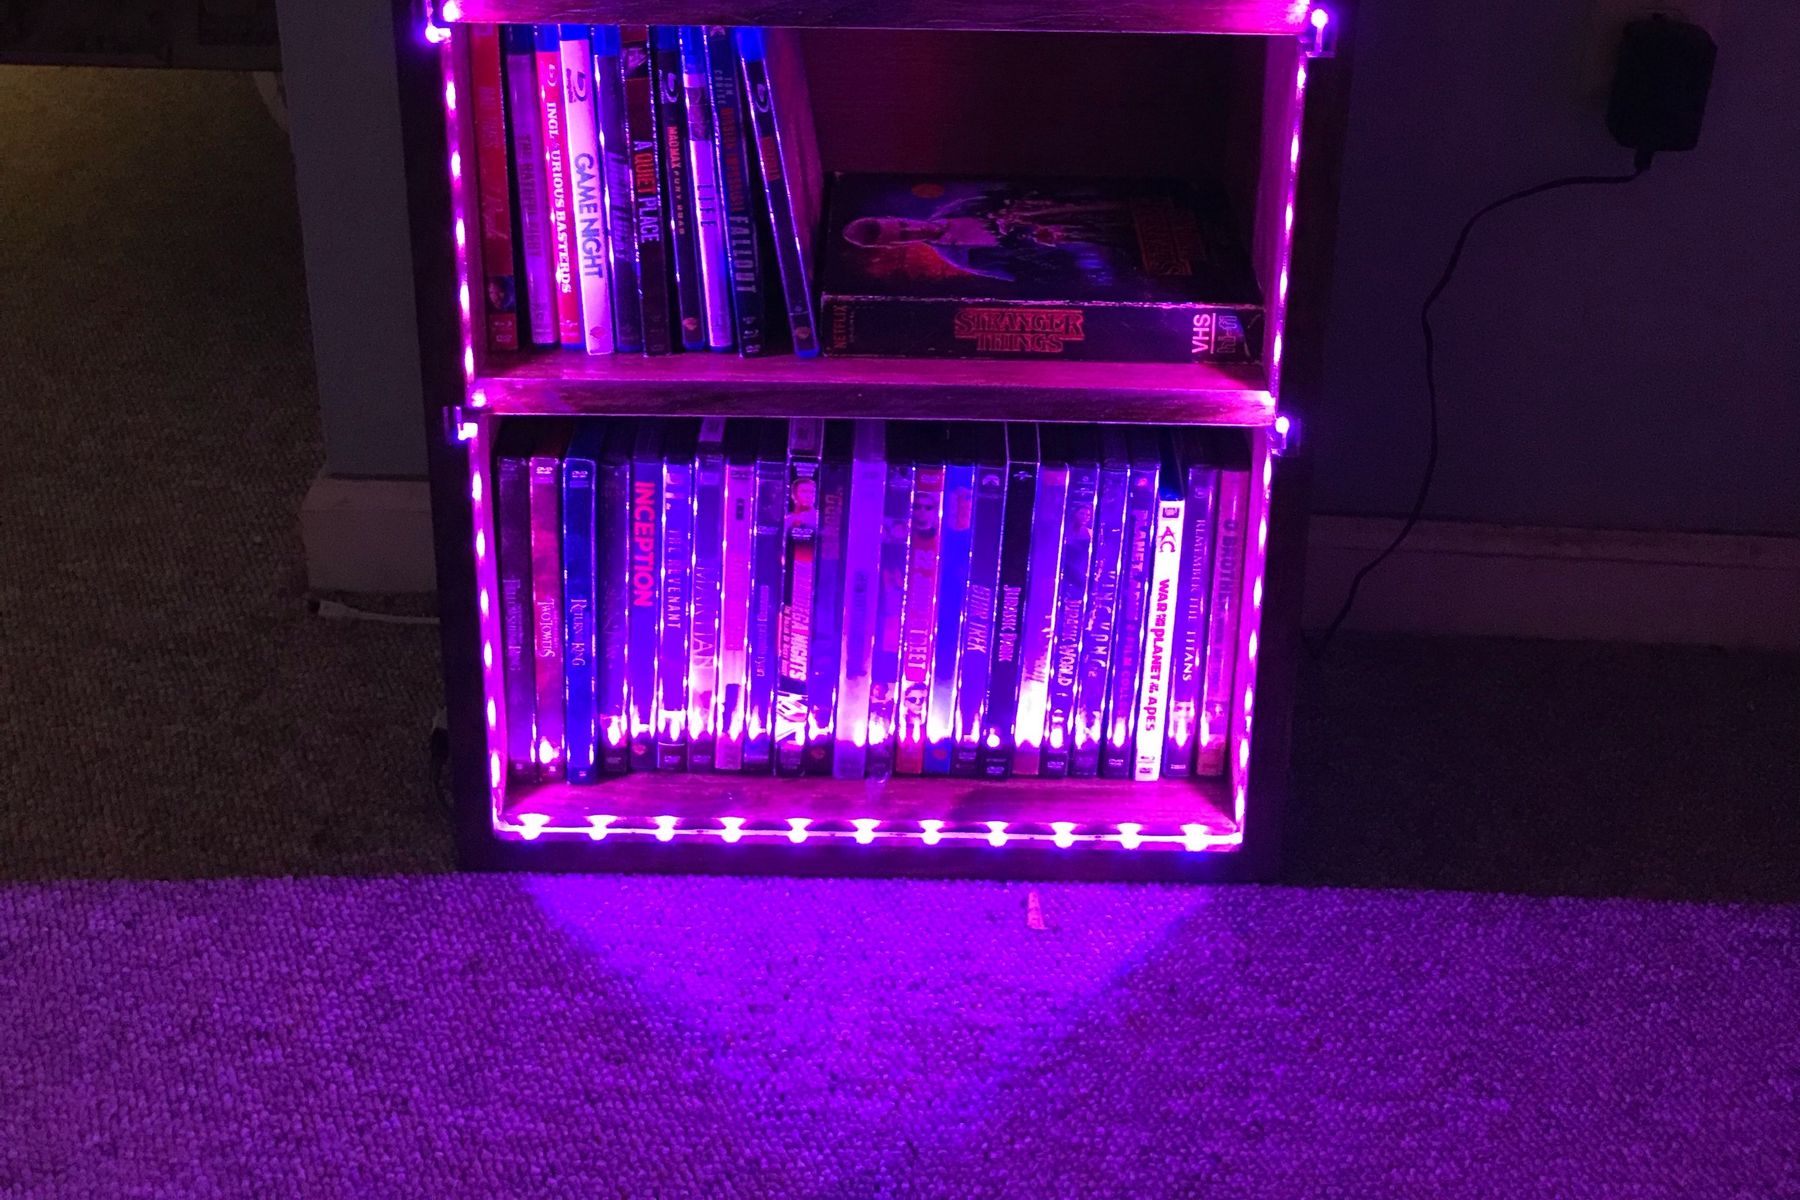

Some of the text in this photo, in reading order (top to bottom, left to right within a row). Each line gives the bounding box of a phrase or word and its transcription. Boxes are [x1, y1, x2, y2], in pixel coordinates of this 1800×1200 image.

[633, 141, 654, 151] A
[667, 126, 679, 148] MAD
[669, 147, 682, 169] MAX
[546, 102, 572, 293] INGLURIOUS BASTERDS
[634, 152, 656, 194] QUIET
[575, 152, 603, 279] GAME NIGHT
[638, 197, 660, 243] PLACE
[697, 184, 718, 229] LIFE
[728, 216, 757, 294] FALLOUT
[833, 305, 848, 350] NETFLIX
[954, 308, 1085, 340] STRANGER
[975, 333, 1065, 354] THINGS
[1192, 313, 1210, 353] VHS
[633, 481, 656, 607] INCEPTION
[1131, 509, 1149, 572] PLANET
[1190, 519, 1206, 592] REMEMBER
[667, 530, 681, 629] THE REVENANT
[1156, 579, 1170, 612] WAR
[570, 599, 588, 666] RETURN KING
[967, 585, 992, 654] STAR TREK
[998, 585, 1021, 662] JURASSIC PARK
[1057, 599, 1082, 686] JURASSIC WORLD
[789, 633, 808, 682] NIGHTS
[1149, 628, 1165, 681] PLANET
[1182, 631, 1197, 681] TITANS
[1143, 696, 1157, 732] APES
